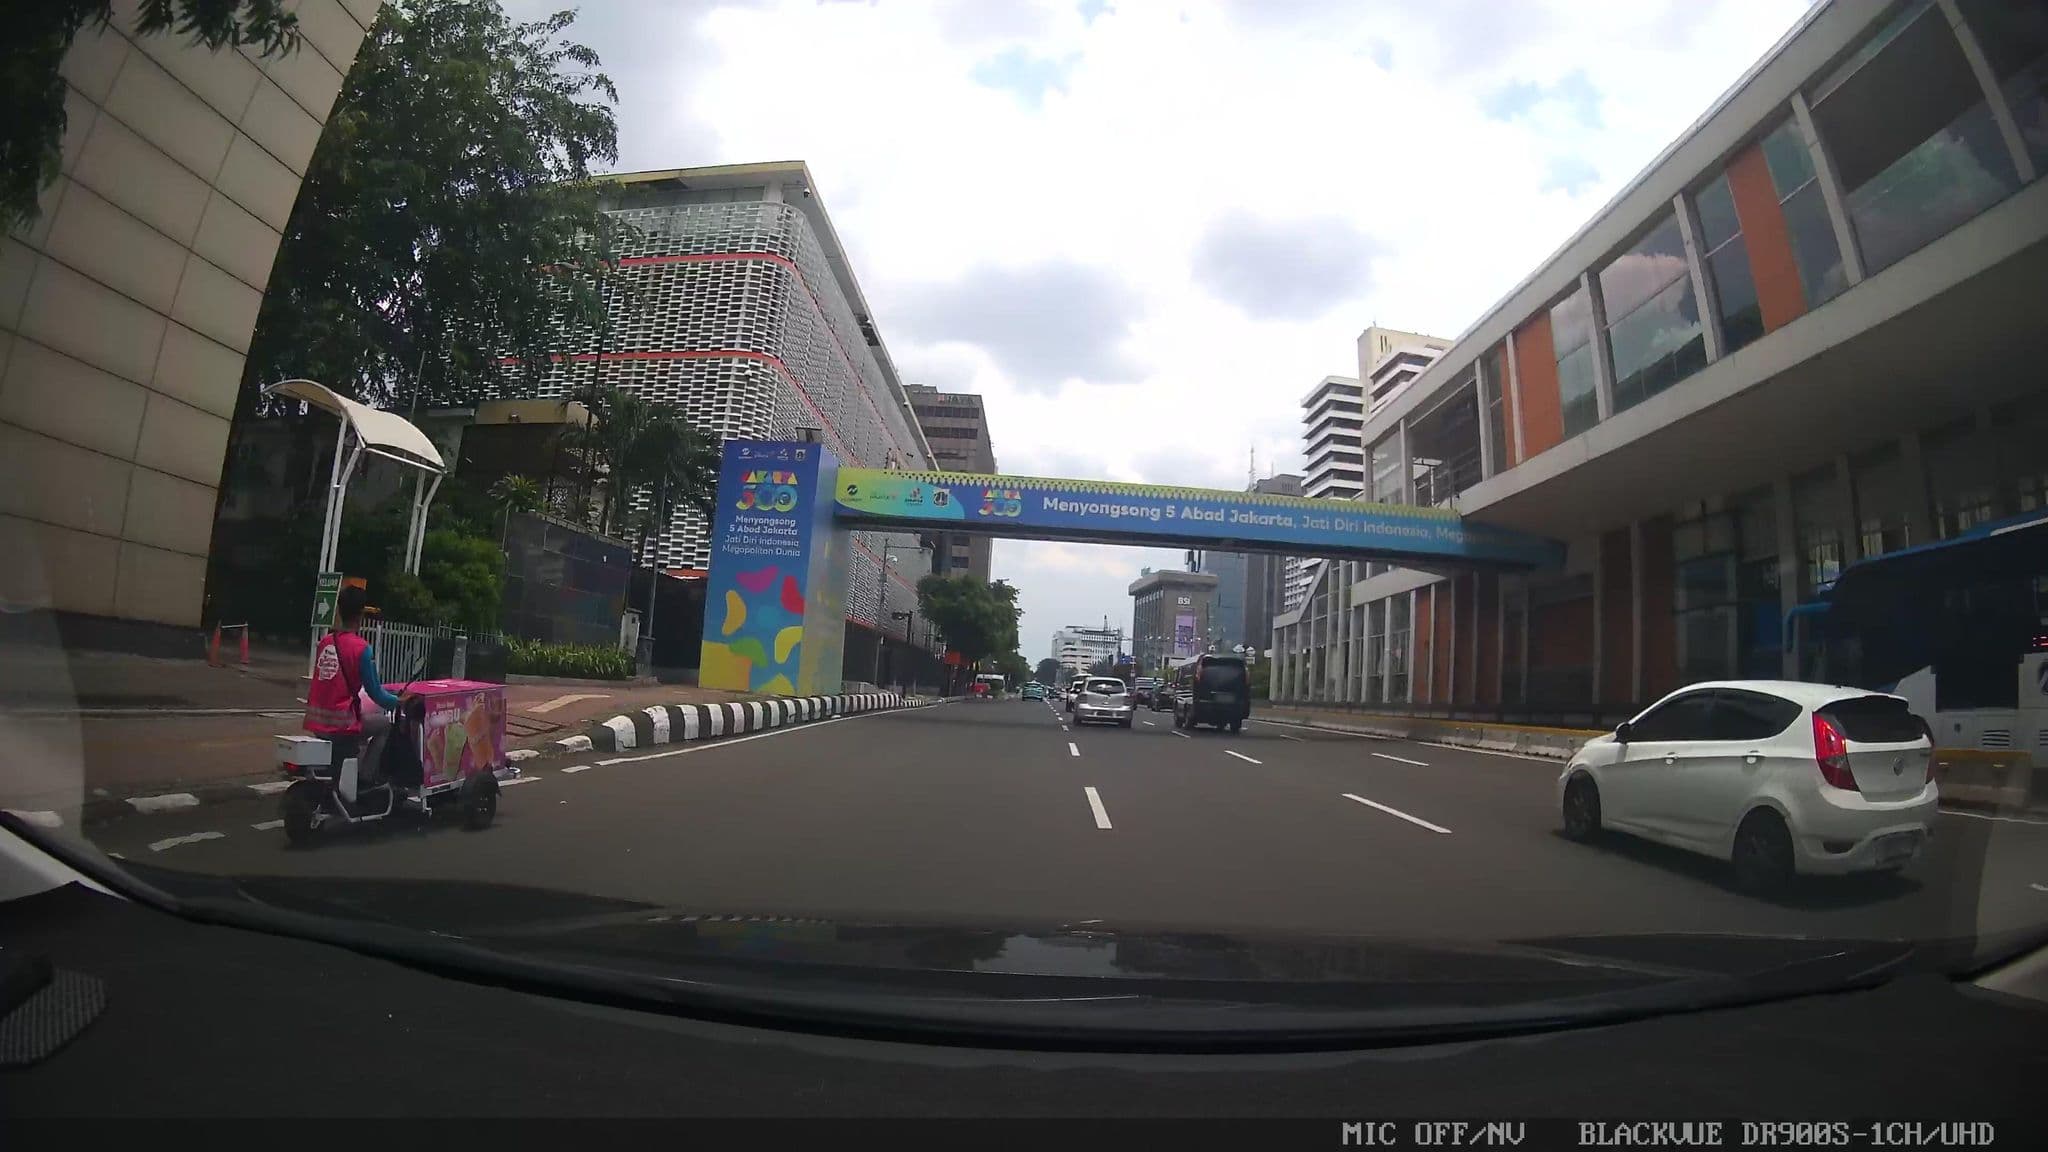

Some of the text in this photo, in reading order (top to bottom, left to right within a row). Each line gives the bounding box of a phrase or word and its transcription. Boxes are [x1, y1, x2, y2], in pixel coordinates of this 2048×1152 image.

[1043, 497, 1160, 521] Menyongsong
[1165, 505, 1175, 518] 5
[1181, 506, 1224, 522] Abad
[1230, 509, 1296, 529] Jakarta,
[1303, 516, 1329, 530] Jati
[1334, 518, 1358, 533] Diri
[736, 515, 796, 527] Menyongsong
[729, 524, 798, 535] 5 Abad Jakarta
[725, 535, 741, 543] Jati
[776, 547, 801, 557] Dunia
